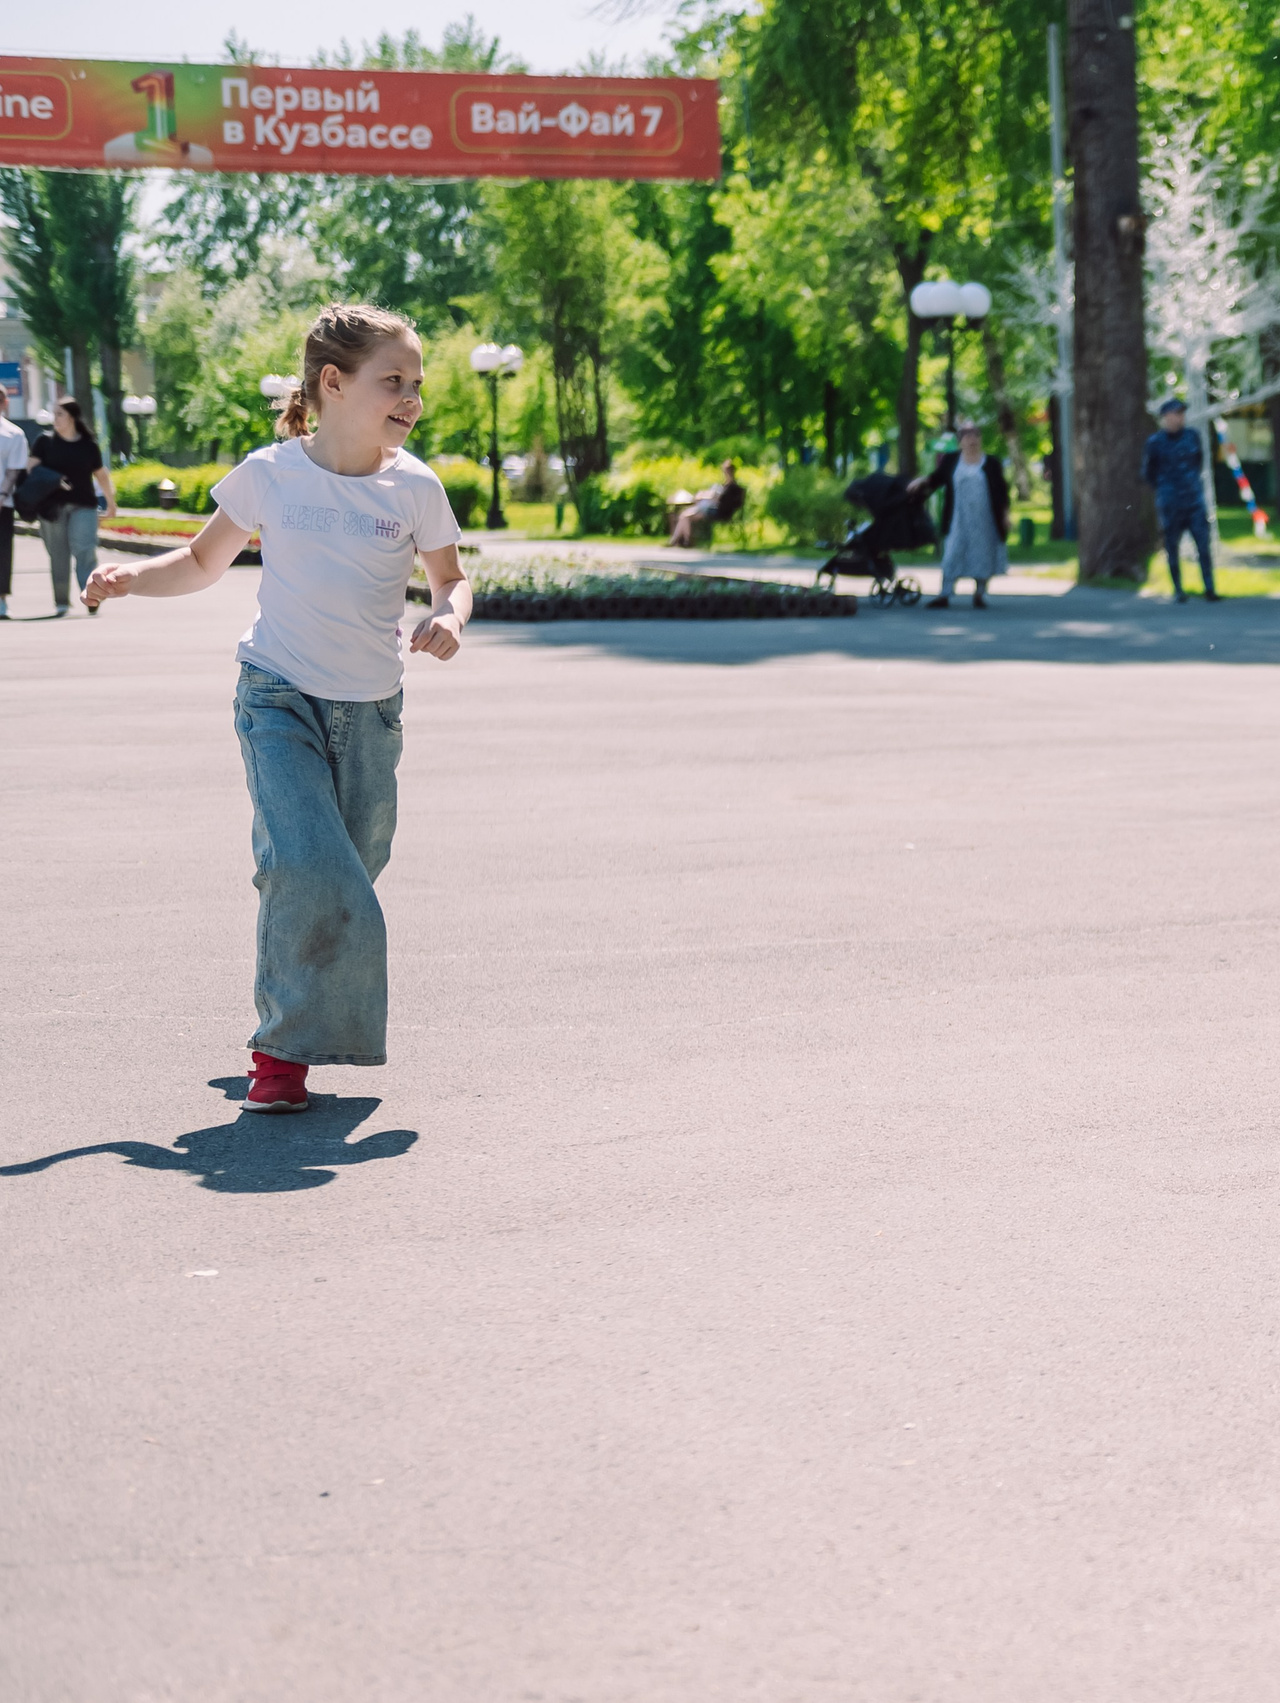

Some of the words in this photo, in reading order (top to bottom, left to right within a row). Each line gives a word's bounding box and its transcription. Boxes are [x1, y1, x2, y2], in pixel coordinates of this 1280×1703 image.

[221, 77, 380, 119] Первый
[223, 120, 246, 145] в
[254, 113, 433, 155] Кузбассе
[471, 101, 635, 138] Вай-Фай
[641, 106, 663, 136] 7
[281, 503, 340, 533] KEEP
